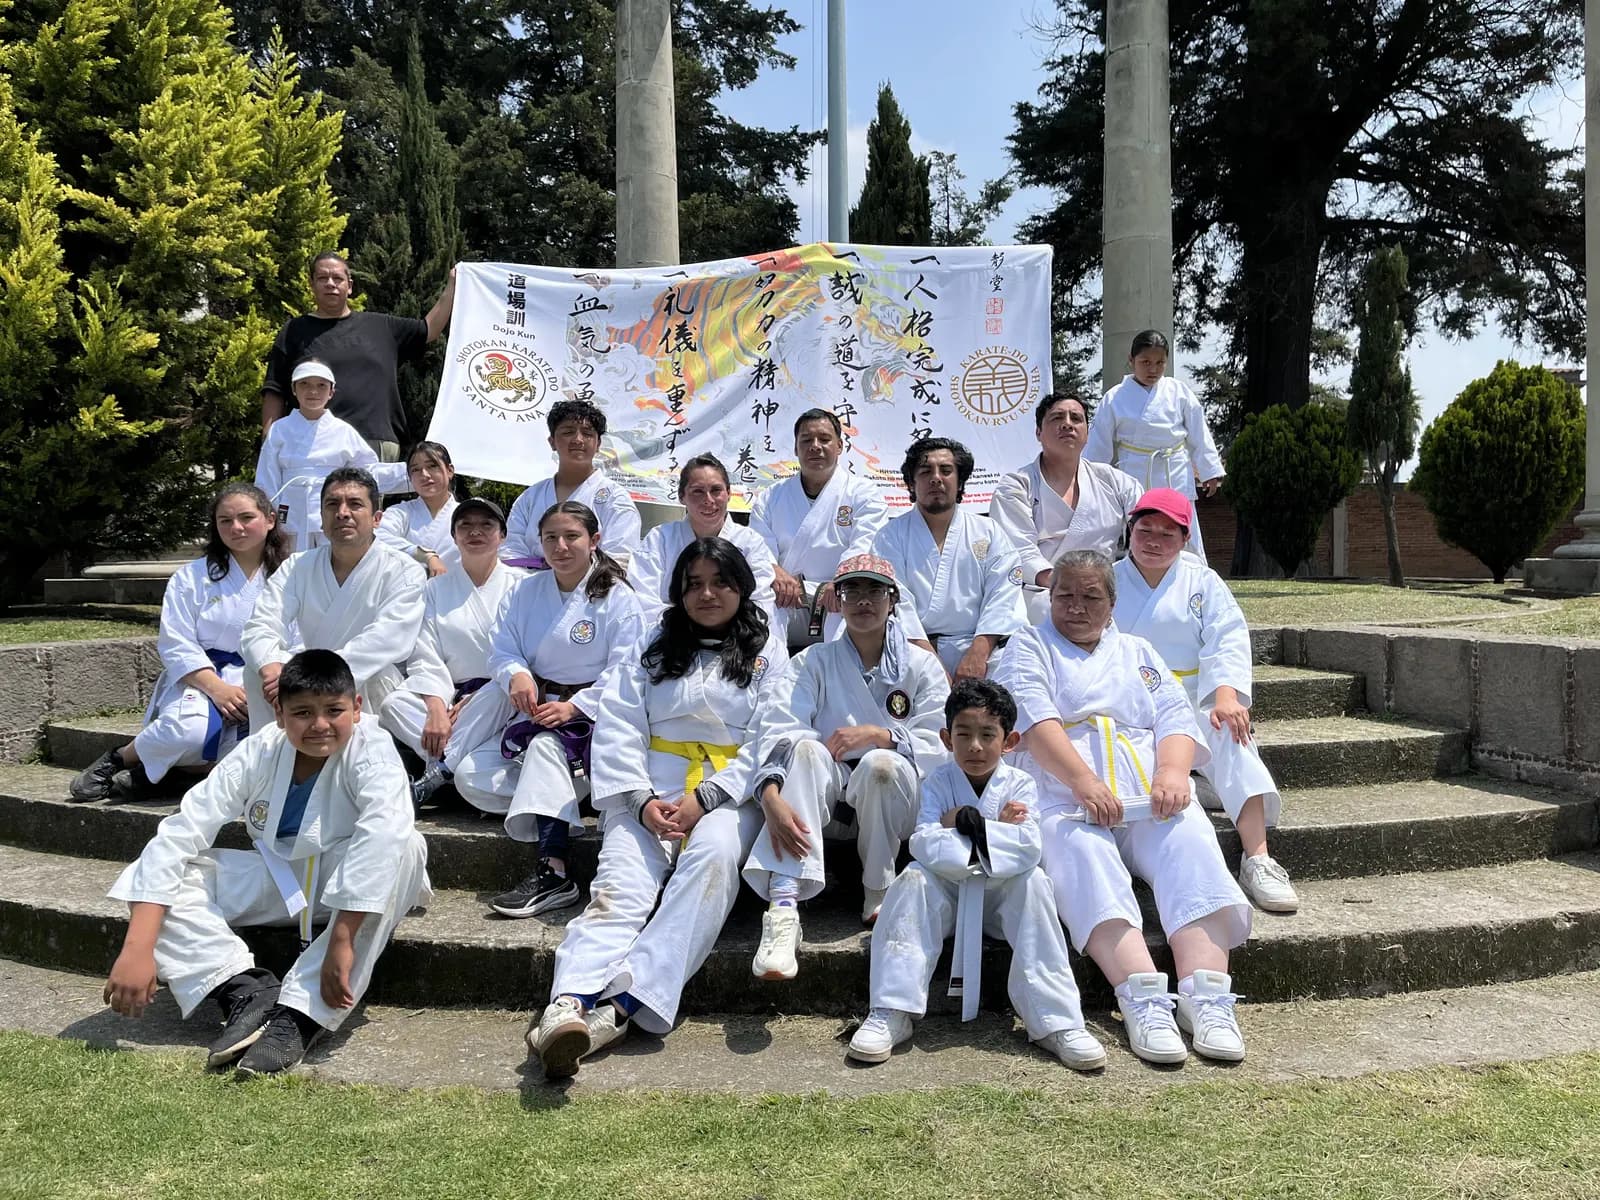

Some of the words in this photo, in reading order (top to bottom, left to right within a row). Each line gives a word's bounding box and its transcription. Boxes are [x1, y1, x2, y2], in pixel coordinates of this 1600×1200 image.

[506, 273, 527, 327] 道場訓
[492, 324, 515, 336] Dojo
[517, 330, 536, 340] Kun
[456, 339, 507, 365] SHOTOKAN
[511, 343, 554, 376] KARATE
[548, 375, 559, 392] DO
[959, 345, 1029, 369] KARATE-DO
[462, 385, 507, 420] SANTA
[516, 409, 546, 423] ANA
[950, 375, 990, 426] SHOTOKAN
[993, 412, 1019, 426] RYU
[1018, 385, 1040, 414] KASE
